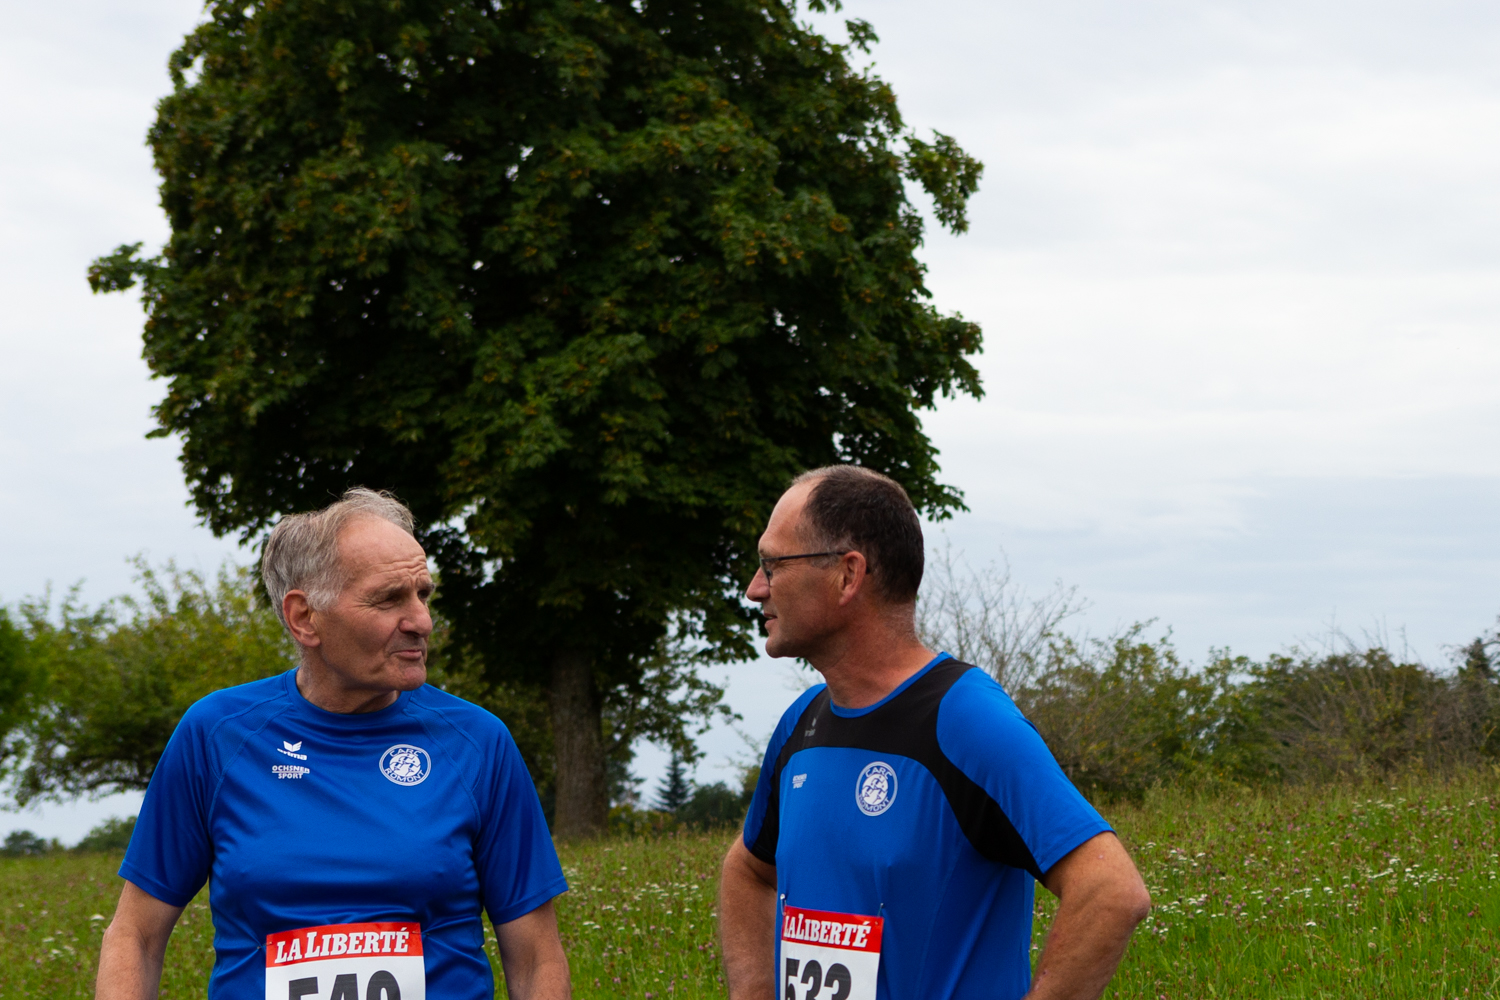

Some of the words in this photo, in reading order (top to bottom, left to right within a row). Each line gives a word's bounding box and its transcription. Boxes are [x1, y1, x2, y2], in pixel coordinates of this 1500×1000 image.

[390, 748, 421, 757] CARC
[384, 768, 424, 782] ROMONT
[865, 767, 892, 780] CARC
